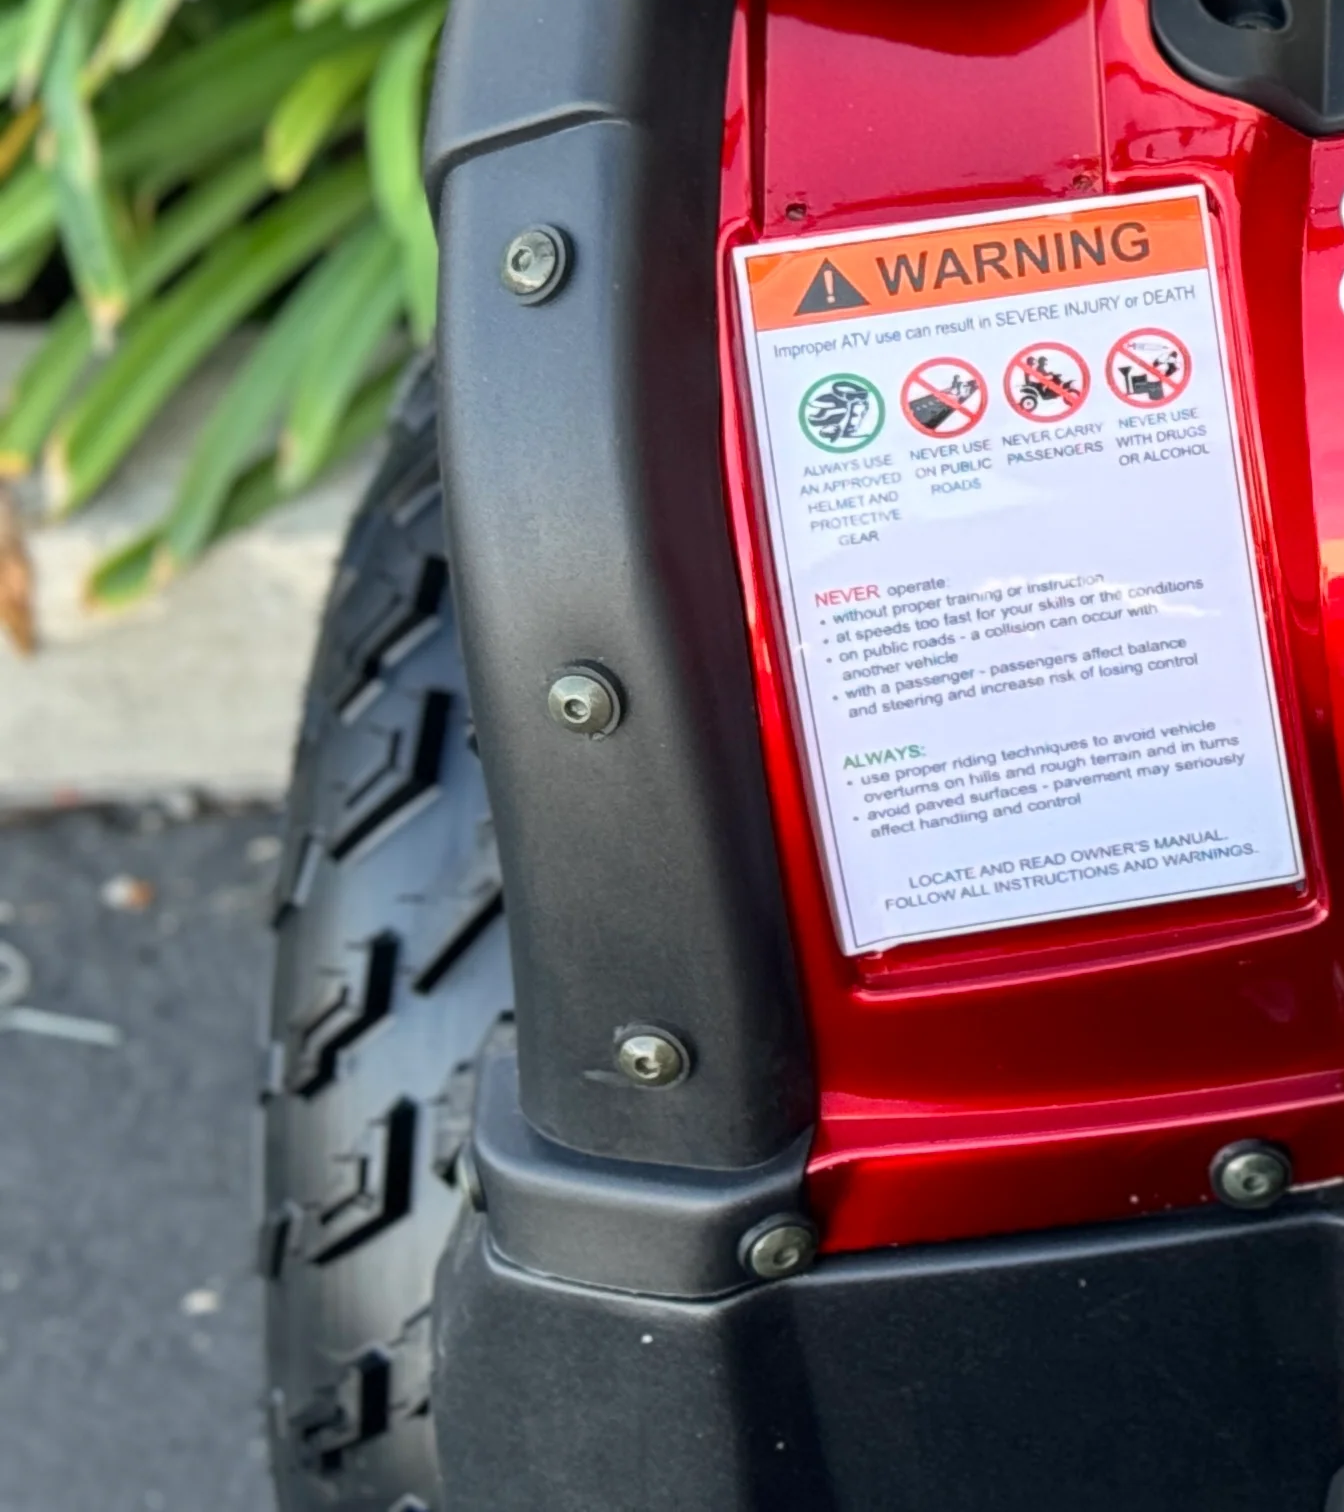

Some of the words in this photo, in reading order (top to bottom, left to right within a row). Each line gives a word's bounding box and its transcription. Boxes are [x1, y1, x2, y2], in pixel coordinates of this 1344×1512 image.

[877, 223, 1149, 294] WARNING
[773, 340, 836, 359] Improper
[841, 332, 870, 348] ATV
[875, 330, 901, 345] use
[905, 326, 932, 340] can
[935, 318, 974, 335] result
[978, 317, 992, 329] in
[995, 304, 1059, 327] SEVERE
[1064, 296, 1119, 316] INJURY
[1124, 296, 1138, 309] or
[1143, 285, 1196, 306] DEATH
[1118, 413, 1166, 428] NEVER
[1171, 407, 1198, 422] USE
[1001, 430, 1051, 446] NEVER
[1055, 423, 1102, 440] CARRY
[1115, 434, 1153, 448] WITH
[1156, 424, 1207, 443] DRUGS
[909, 444, 959, 460] NEVER
[963, 438, 990, 454] USE
[1007, 440, 1104, 465] PASSENGERS
[1118, 453, 1140, 466] OR
[1143, 444, 1210, 462] ALCOHOL
[803, 459, 860, 477] ALWAYS
[864, 454, 892, 469] USE
[915, 466, 937, 479] ON
[940, 457, 992, 474] PUBLIC
[800, 484, 820, 496] AN
[824, 472, 902, 492] APPROVED
[930, 478, 982, 495] ROADS
[808, 495, 864, 514] HELMET
[869, 490, 899, 504] AND
[810, 509, 901, 531] PROTECTIVE
[839, 530, 880, 546] GEAR
[814, 584, 880, 607] NEVER
[833, 605, 887, 624] without
[892, 598, 941, 617] proper
[946, 589, 1003, 606] training
[1006, 586, 1022, 598] or
[836, 630, 851, 644] at
[855, 623, 911, 641] speeds
[914, 618, 940, 631] too
[943, 611, 972, 626] fast
[976, 608, 995, 620] for
[1000, 603, 1033, 620] your
[1038, 596, 1075, 611] skills
[1079, 594, 1095, 606] or
[1128, 579, 1204, 597] conditions
[839, 650, 859, 663] on
[863, 642, 908, 661] public
[912, 634, 956, 650] roads
[970, 630, 981, 641] a
[984, 620, 1045, 638] collision
[1049, 615, 1078, 629] can
[1081, 609, 1123, 624] occur
[1127, 604, 1158, 618] with
[842, 662, 900, 681] another
[905, 652, 958, 670] vehicle
[845, 684, 876, 699] with
[881, 683, 891, 694] a
[895, 669, 974, 693] passenger
[990, 653, 1077, 677] passengers
[1082, 645, 1123, 661] affect
[1127, 638, 1187, 655] balance
[848, 702, 877, 719] and
[882, 693, 943, 713] steering
[948, 685, 976, 702] and
[980, 677, 1044, 695] increase
[1049, 670, 1075, 684] risk
[1080, 666, 1094, 680] of
[1098, 663, 1143, 677] losing
[1147, 653, 1198, 671] control
[843, 744, 925, 769] ALWAYS:
[860, 772, 890, 786] use
[895, 761, 947, 782] proper
[952, 753, 997, 769] riding
[1001, 739, 1088, 761] techniques
[1092, 735, 1109, 747] to
[1113, 727, 1156, 744] avoid
[1160, 720, 1216, 737] vehicle
[944, 777, 965, 790] on
[969, 770, 1001, 785] hills
[1006, 764, 1036, 779] and
[1040, 757, 1086, 773] rough
[1090, 750, 1142, 766] terrain
[1147, 742, 1176, 758] and
[1181, 742, 1195, 753] in
[867, 803, 910, 821] avoid
[915, 793, 965, 815] paved
[970, 784, 1038, 803] surfaces
[1053, 768, 1132, 791] pavement
[1136, 764, 1170, 777] may
[1175, 753, 1245, 772] seriously
[870, 821, 915, 838] affect
[919, 810, 988, 829] handling
[993, 802, 1023, 818] and
[1027, 793, 1082, 812] control
[908, 867, 975, 889] LOCATE
[980, 861, 1015, 877] AND
[1019, 853, 1066, 871] READ
[1070, 840, 1150, 862] OWNER'S
[1154, 830, 1227, 849] MANUAL.
[885, 889, 956, 910] FOLLOW
[960, 885, 990, 899] ALL
[994, 863, 1119, 893] INSTRUCTIONS
[1123, 857, 1159, 873] AND
[1162, 843, 1257, 866] WARNINGS.
